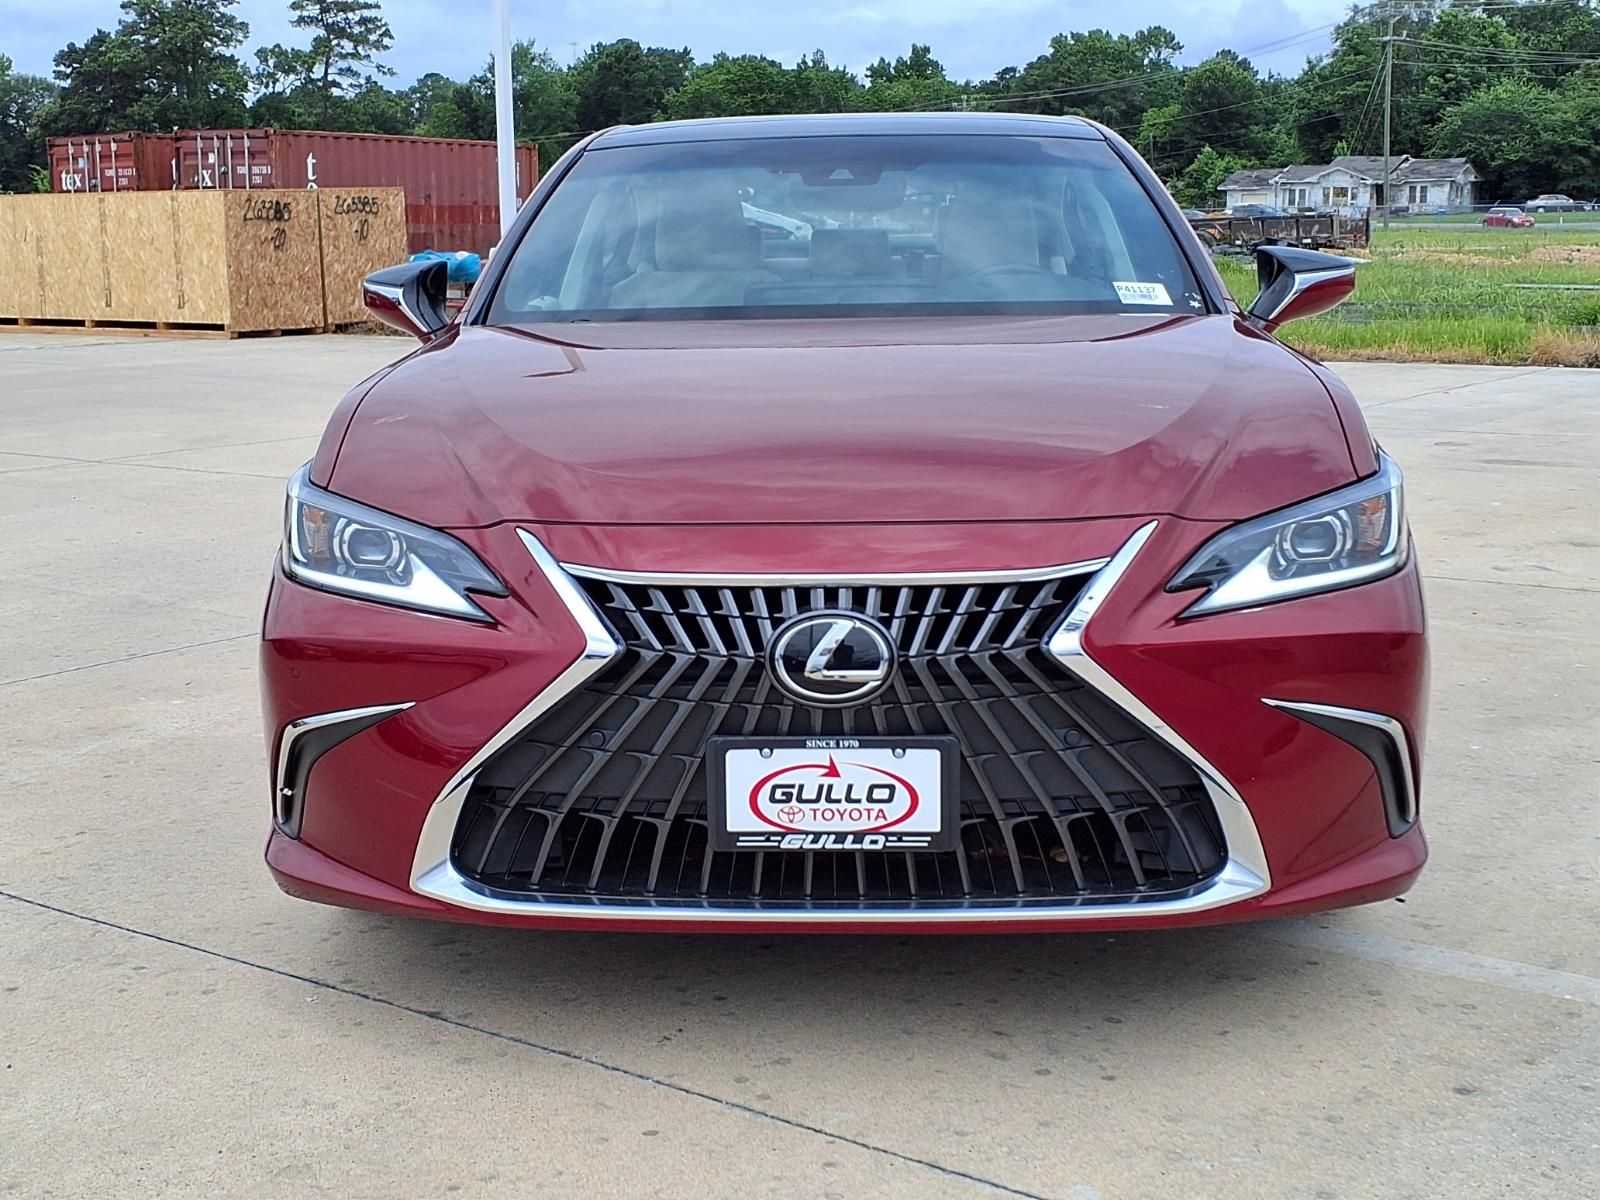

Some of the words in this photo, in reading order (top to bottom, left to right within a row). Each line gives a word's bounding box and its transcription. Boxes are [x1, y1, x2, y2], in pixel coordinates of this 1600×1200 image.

[1116, 285, 1156, 294] P41137
[805, 739, 837, 748] SINCE
[839, 739, 860, 748] 1970
[768, 783, 897, 804] GULLO
[809, 808, 888, 822] TOYOTA
[779, 834, 886, 850] GULLO
